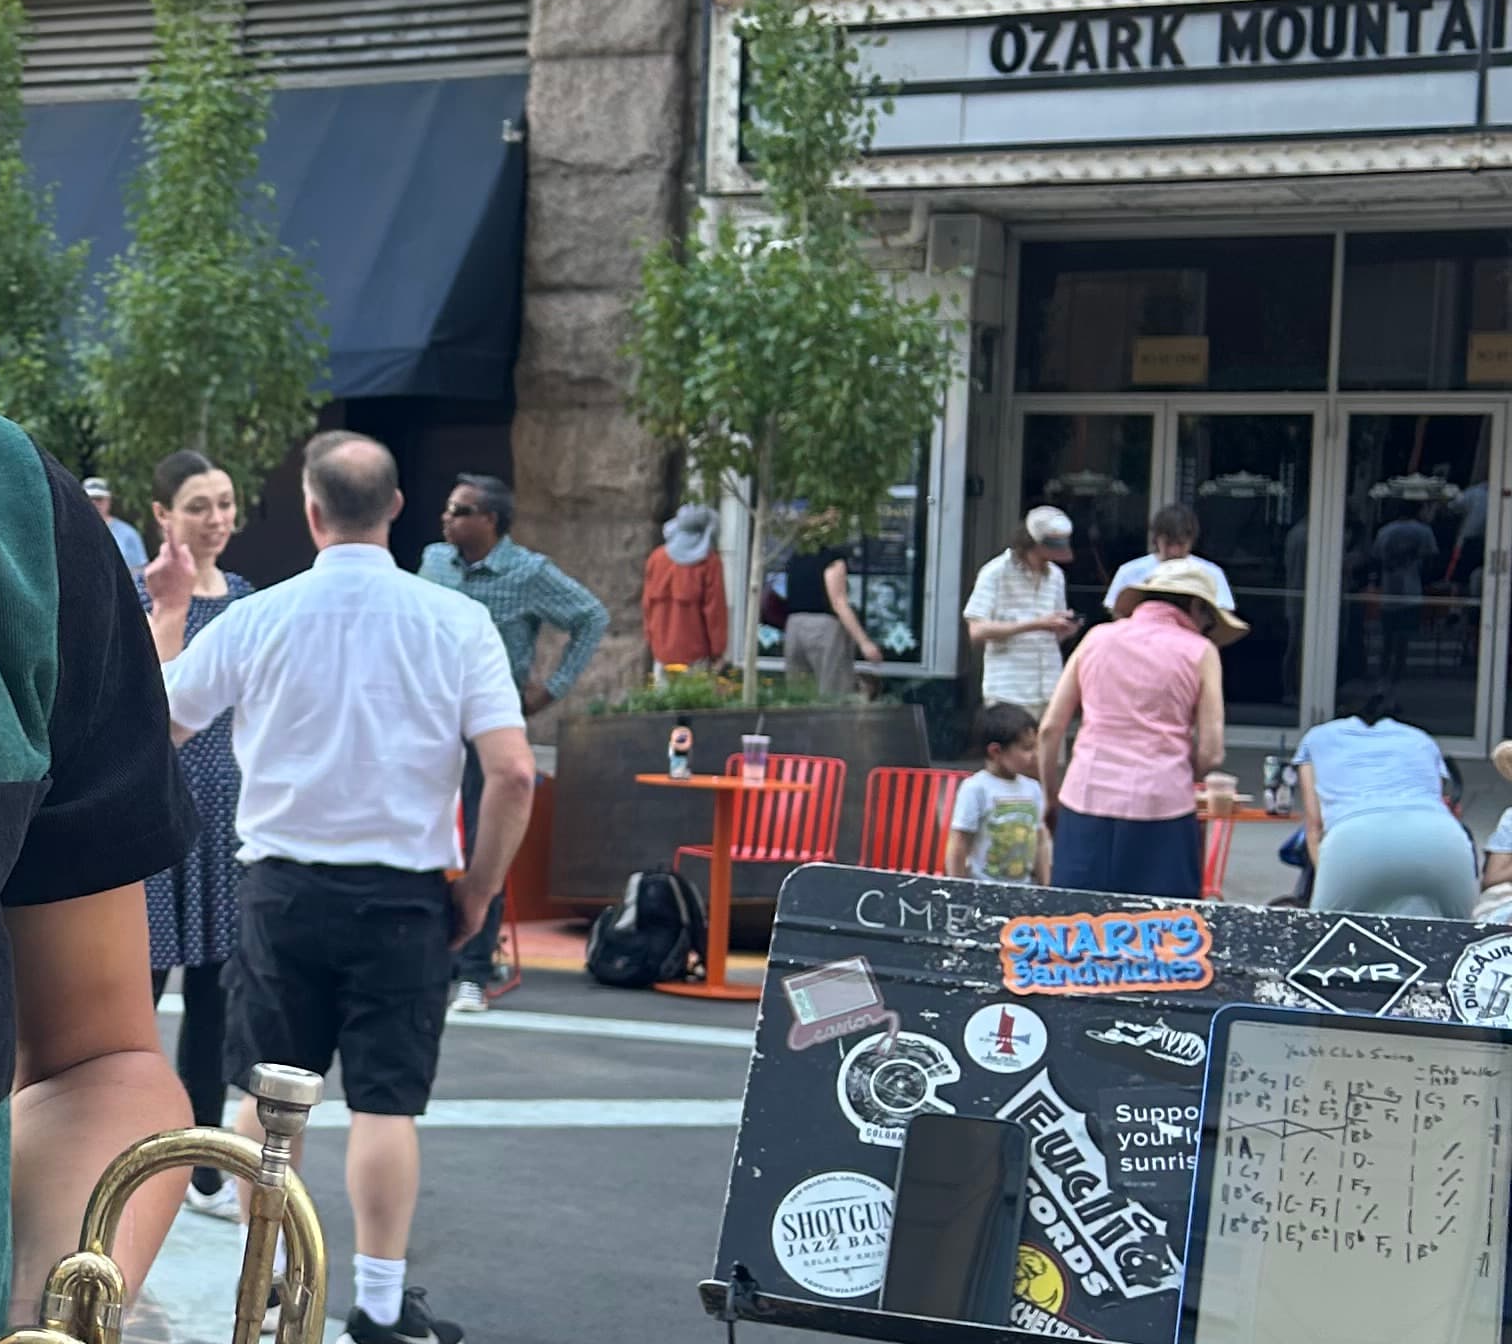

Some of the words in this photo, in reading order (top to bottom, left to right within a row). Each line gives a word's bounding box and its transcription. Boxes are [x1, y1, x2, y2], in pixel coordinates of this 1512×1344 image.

[989, 11, 1185, 74] OZARK
[1010, 915, 1204, 963] SNARF'S
[1306, 962, 1403, 986] YYR
[1117, 1131, 1175, 1151] your
[787, 1238, 839, 1258] JAZZ
